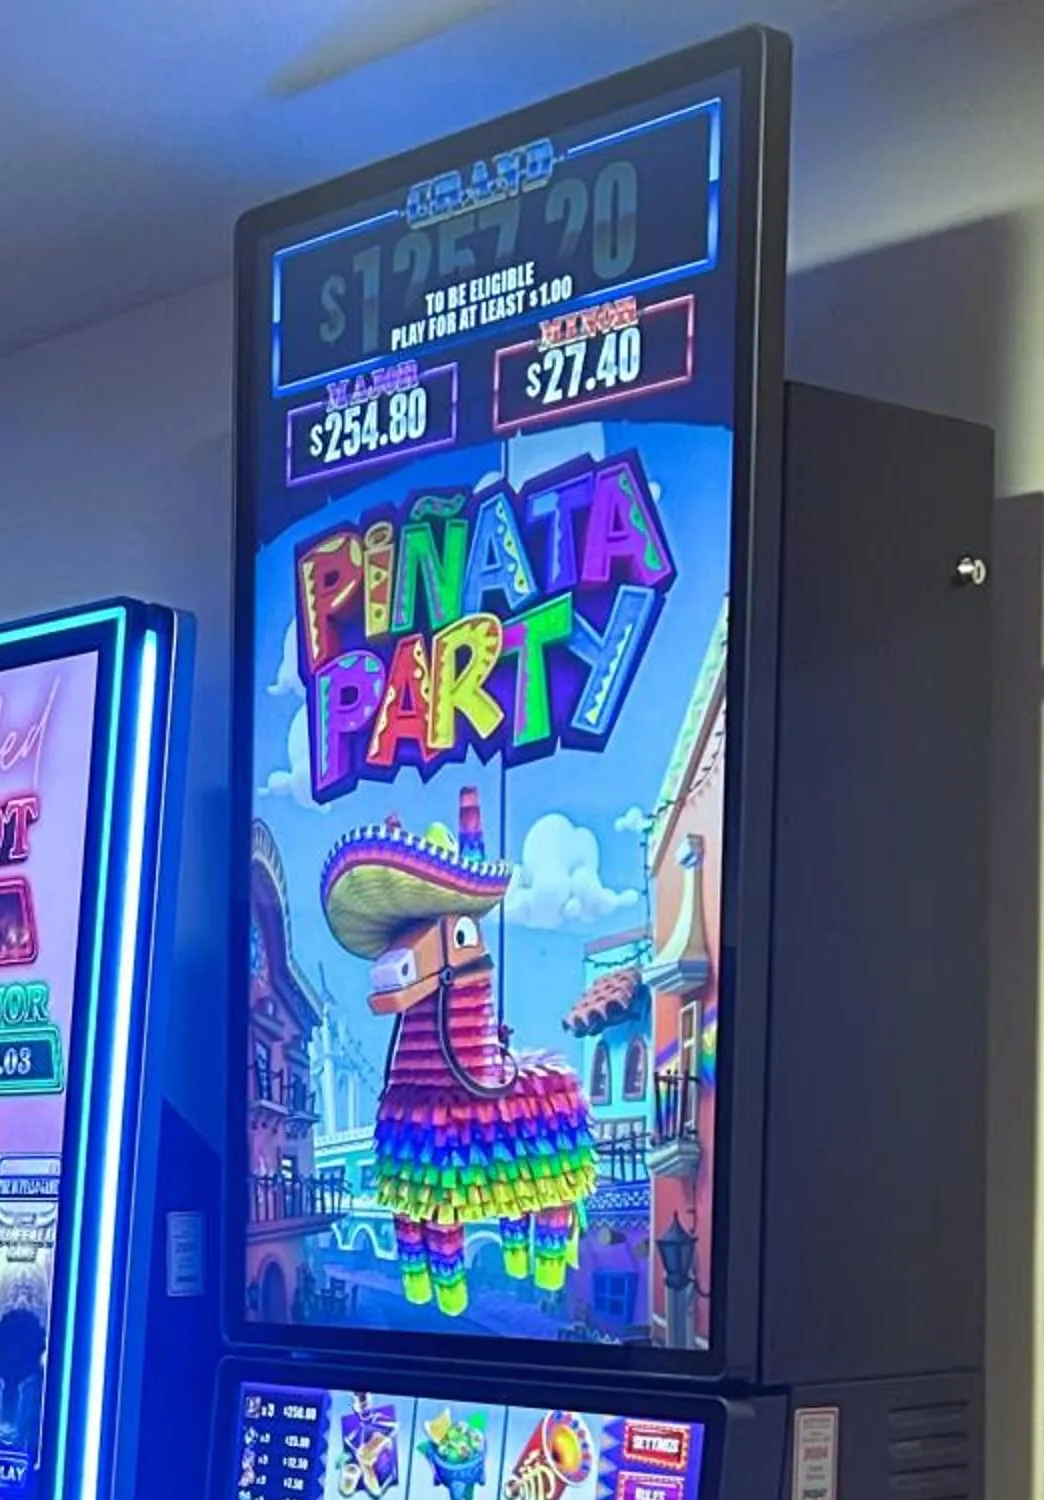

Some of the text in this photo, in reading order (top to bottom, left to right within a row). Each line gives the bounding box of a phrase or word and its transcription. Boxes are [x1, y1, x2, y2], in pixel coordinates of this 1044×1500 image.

[391, 275, 573, 351] PLAY FOR AT LEAST $1.00
[425, 261, 535, 316] TO BE ELIGIBLE
[525, 327, 641, 404] $27.40
[309, 387, 427, 463] $254.80
[313, 584, 656, 792] PARTY
